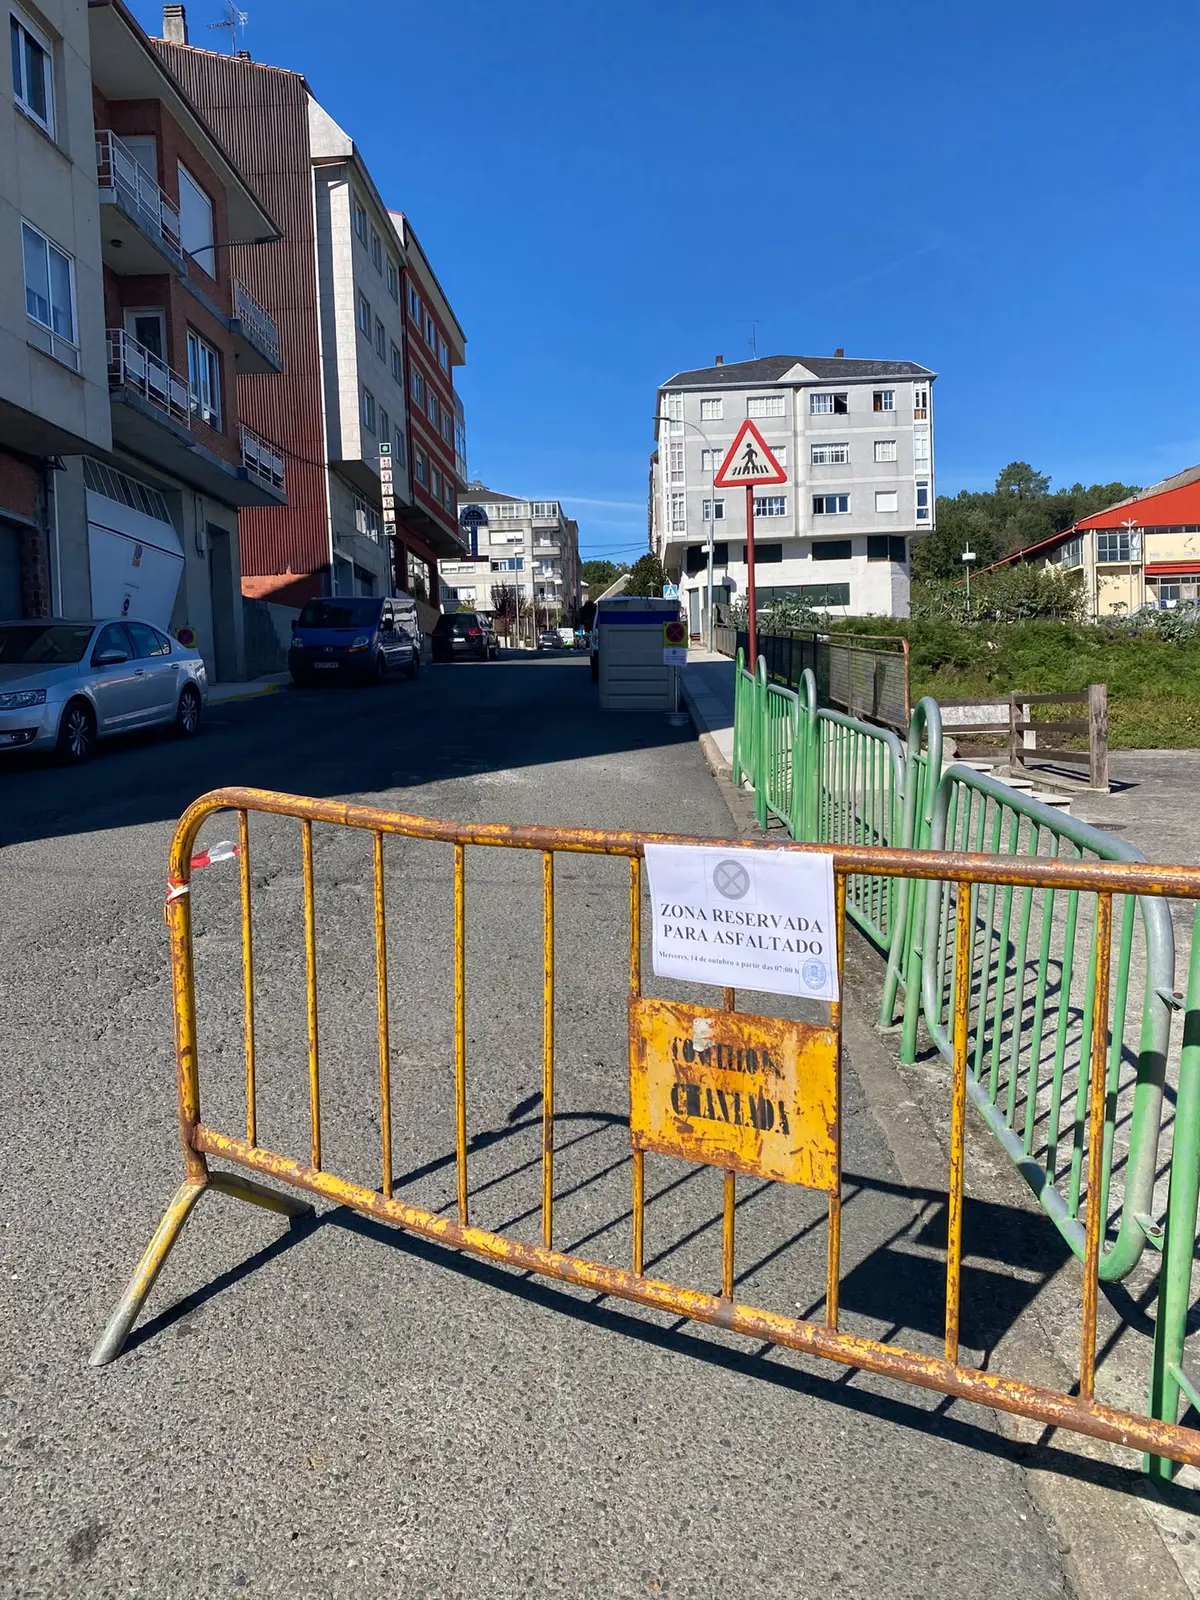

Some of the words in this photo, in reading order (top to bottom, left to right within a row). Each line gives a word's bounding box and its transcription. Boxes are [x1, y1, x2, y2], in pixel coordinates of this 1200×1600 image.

[660, 903, 708, 921] ZONA
[712, 908, 824, 934] RESERVADA
[663, 924, 708, 942] PARA
[713, 930, 823, 956] ASFALTADO
[699, 955, 707, 963] de
[708, 957, 734, 967] outubro
[741, 961, 760, 969] partir
[762, 963, 774, 971] das
[774, 965, 793, 974] 07:00
